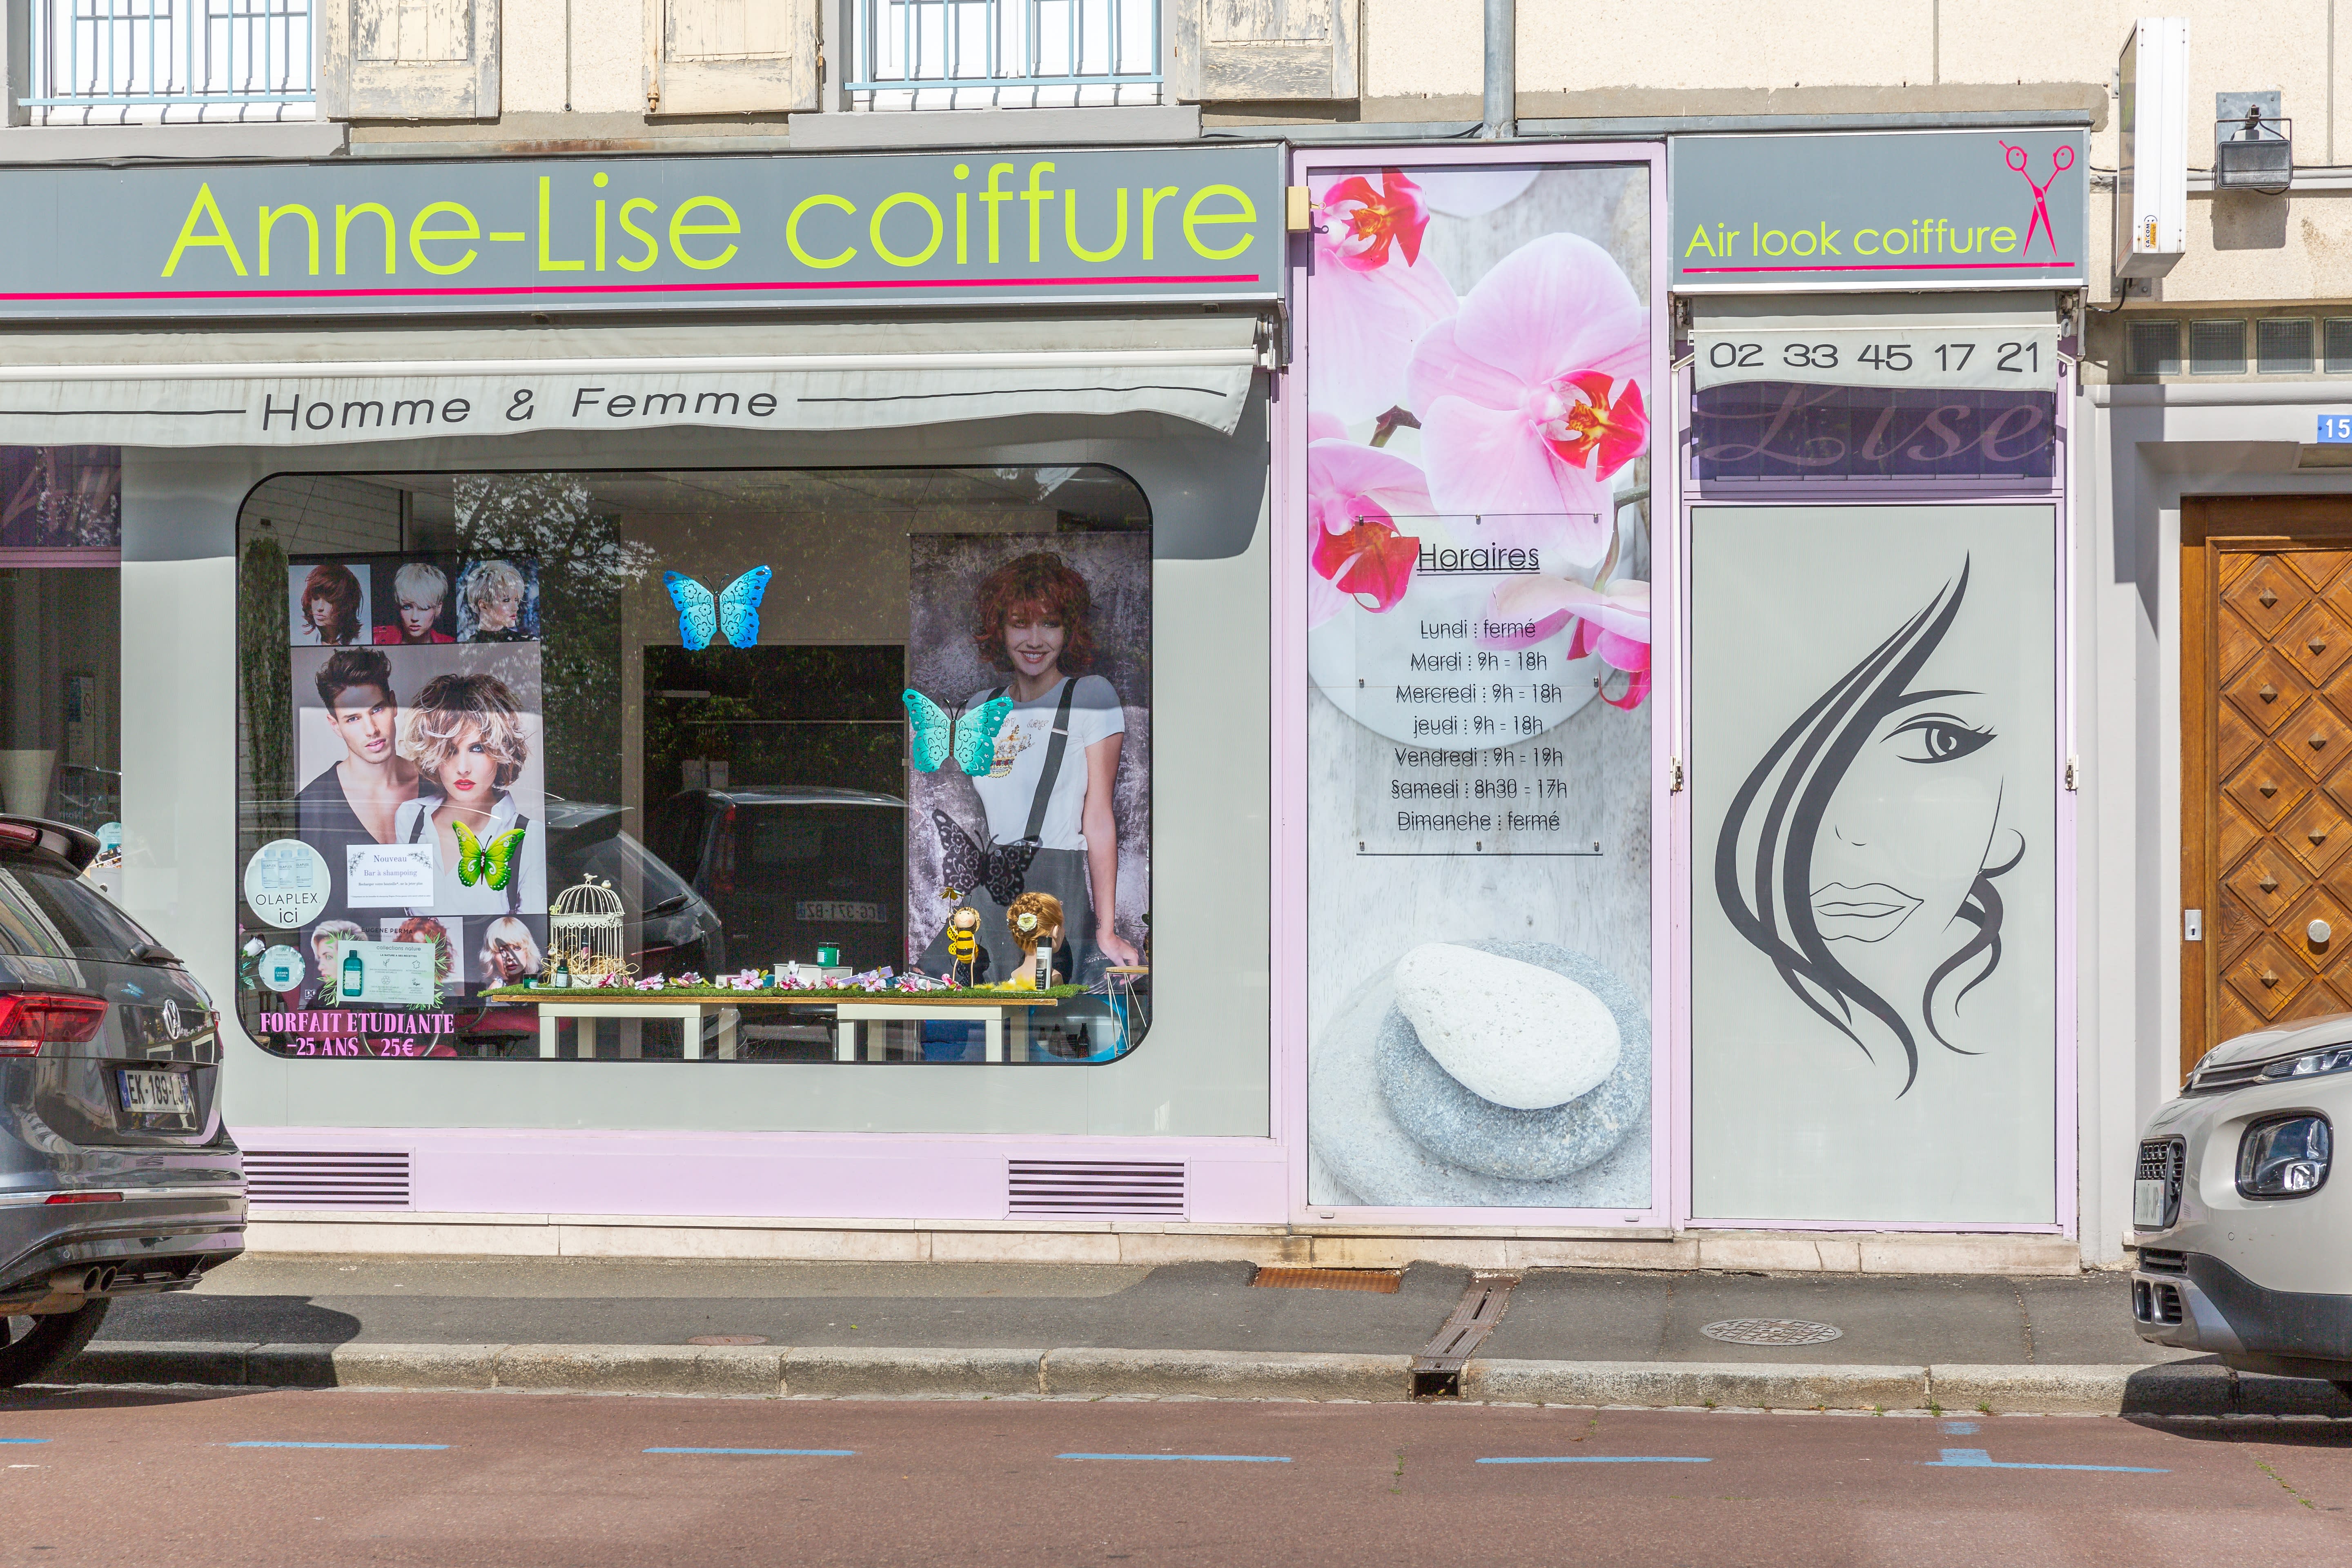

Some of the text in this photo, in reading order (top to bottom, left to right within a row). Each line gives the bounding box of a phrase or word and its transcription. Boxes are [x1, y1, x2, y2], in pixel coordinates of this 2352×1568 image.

[161, 161, 1257, 277] Anne-Lise coiffure
[1684, 218, 2016, 257] Air look coiffure
[1709, 341, 2038, 372] 02 33 45 17 21
[263, 387, 777, 431] Homme & Femme
[1694, 381, 2054, 466] Lise
[2325, 418, 2350, 439] 15
[1419, 542, 1539, 567] Horaires
[1421, 619, 1467, 634] Lundi
[1483, 618, 1536, 634] fermé
[1411, 652, 1461, 666] Mardi
[1478, 652, 1498, 666] 9h
[1518, 652, 1547, 666] 18h
[1396, 684, 1476, 698] Mercredi
[1492, 684, 1512, 698] 9h
[1532, 684, 1561, 698] 18h
[1413, 715, 1457, 734] jeudi
[1474, 715, 1494, 730] 9h
[1514, 715, 1543, 730] 18h
[1394, 747, 1477, 762] Vendredi
[1493, 747, 1514, 762] 9h
[1534, 747, 1563, 762] 19h
[1391, 779, 1458, 794] Samedi
[1474, 779, 1517, 794] 8h30
[1537, 779, 1567, 794] 17h
[1398, 811, 1491, 826] Dimanche
[1508, 810, 1559, 826] fermé
[256, 893, 318, 905] OLAPLEX
[279, 907, 298, 923] ici
[260, 1012, 454, 1034] FORFAIT ETUDIANTE
[287, 1037, 414, 1056] -25 ANS 25€
